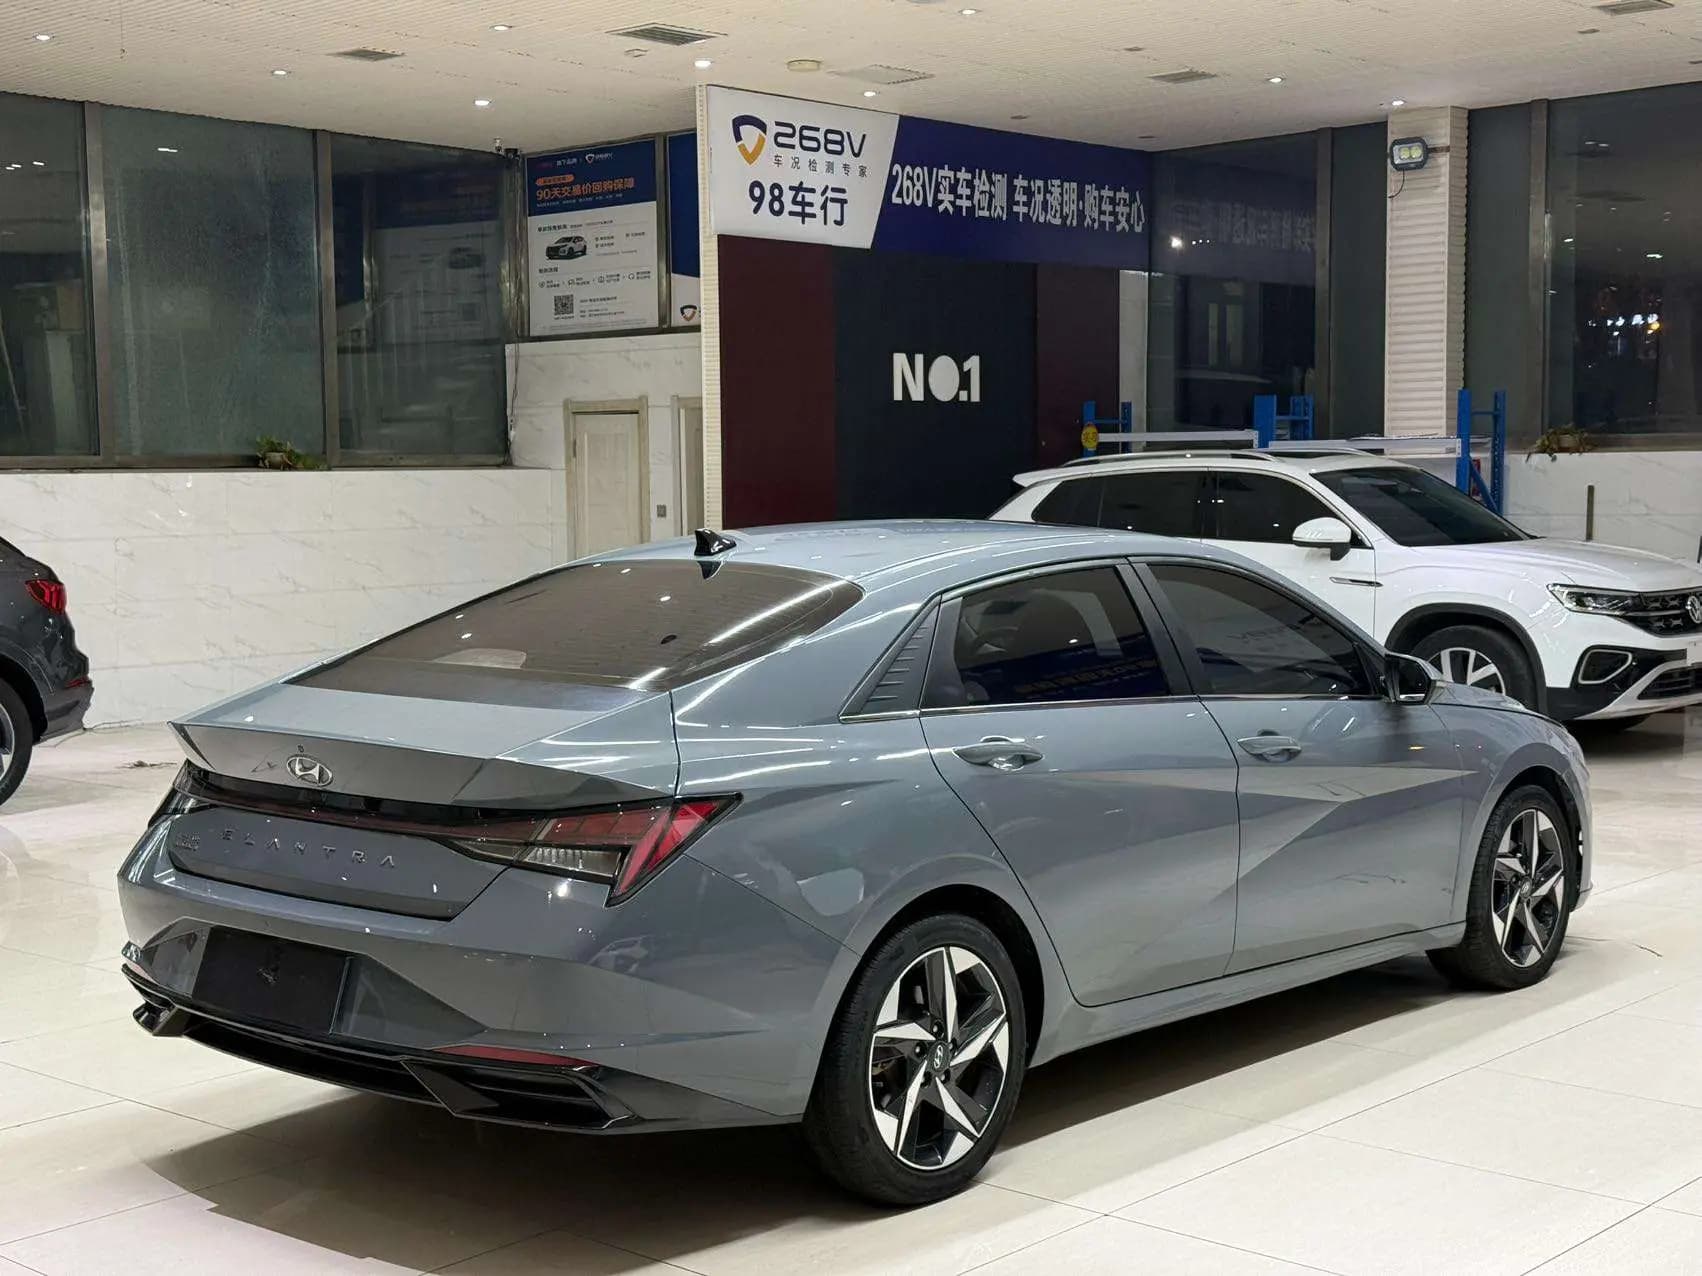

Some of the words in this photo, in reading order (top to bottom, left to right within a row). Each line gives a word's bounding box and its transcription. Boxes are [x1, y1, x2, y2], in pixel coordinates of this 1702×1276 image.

[774, 121, 866, 158] 268V
[773, 154, 868, 178] 车况检测专家
[536, 177, 635, 201] 90天交易价回购保障
[749, 180, 849, 227] 98车行
[891, 163, 1007, 221] 268V实车检测
[222, 828, 395, 868] ELANTRA
